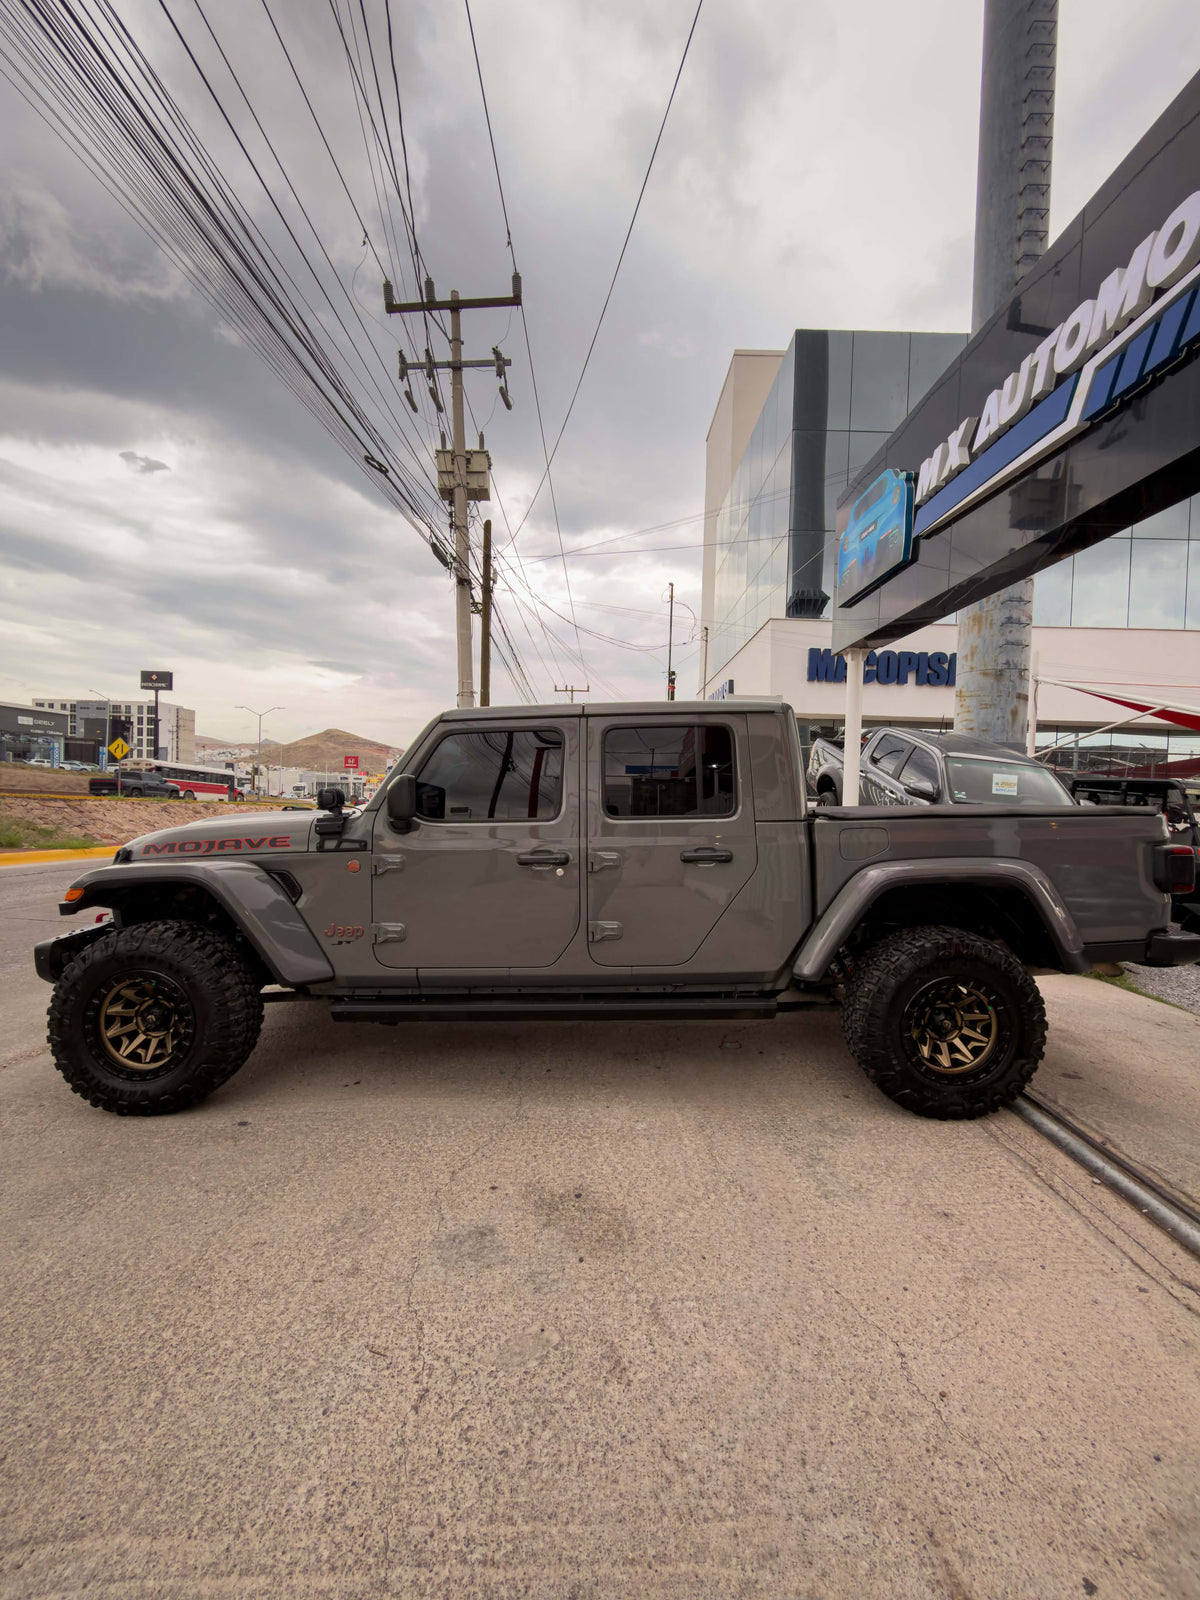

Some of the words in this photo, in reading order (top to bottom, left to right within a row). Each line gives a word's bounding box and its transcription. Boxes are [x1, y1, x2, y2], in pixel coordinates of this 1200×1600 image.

[914, 416, 978, 505] MX
[141, 835, 292, 856] MOJAVE
[323, 922, 366, 940] Jeep
